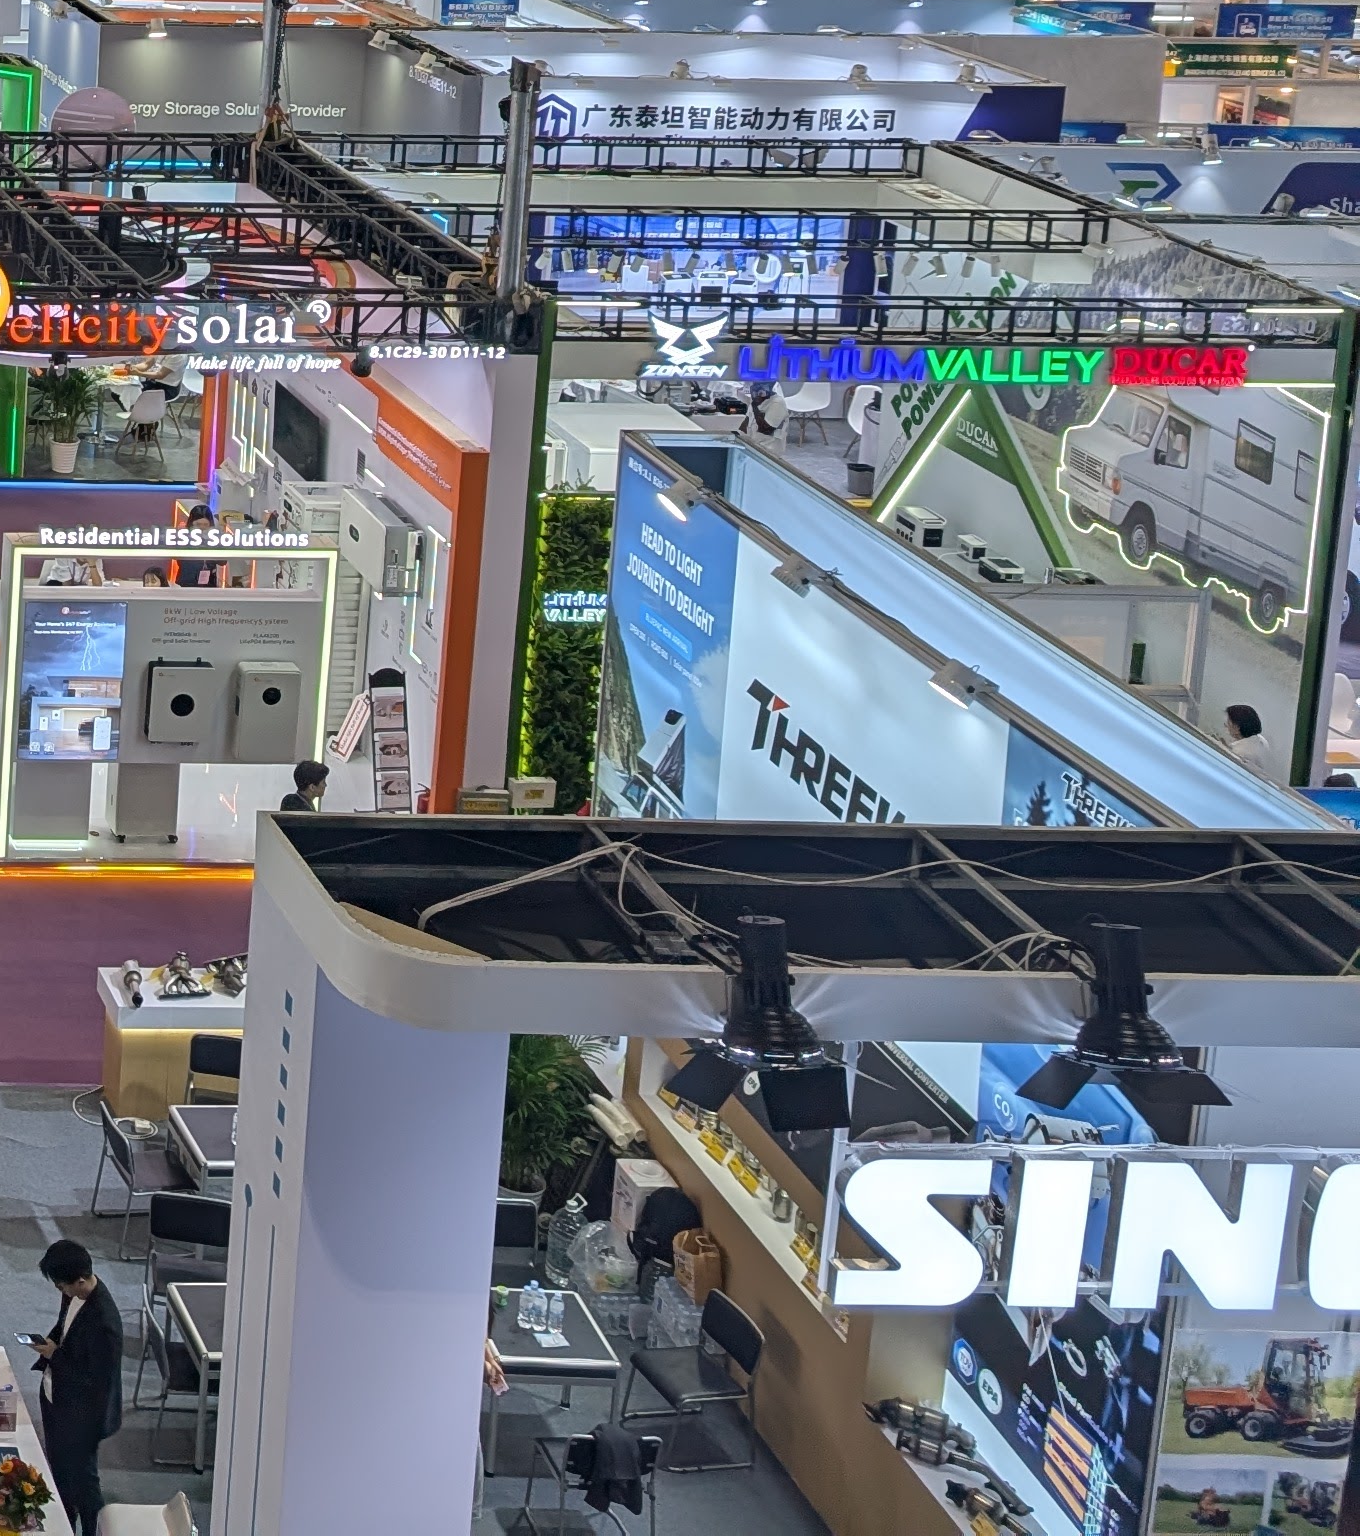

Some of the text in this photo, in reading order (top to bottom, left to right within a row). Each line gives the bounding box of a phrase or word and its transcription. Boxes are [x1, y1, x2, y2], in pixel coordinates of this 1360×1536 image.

[129, 101, 346, 118] ergy Storage Solut Provider
[581, 104, 897, 133] 广东泰坦智能动力有限公司
[369, 345, 506, 360] 8.1C29-30 D11-12
[186, 354, 342, 373] Make life full of hope
[639, 364, 729, 378] ZONSEN
[926, 349, 1105, 384] VALLEY
[1112, 346, 1249, 376] DUCAR
[39, 526, 310, 547] Residential ESS Solutions
[640, 522, 704, 587] HEAD TO LIGHT
[626, 552, 665, 599] JOURNEY
[664, 580, 676, 608] TO
[676, 590, 715, 638] DELIGHT
[198, 617, 216, 626] High
[207, 608, 238, 617] Voltage
[543, 608, 607, 622] VALLEY
[884, 1041, 950, 1105] UNIVERSAL CONVERTER
[981, 1378, 999, 1406] EPA
